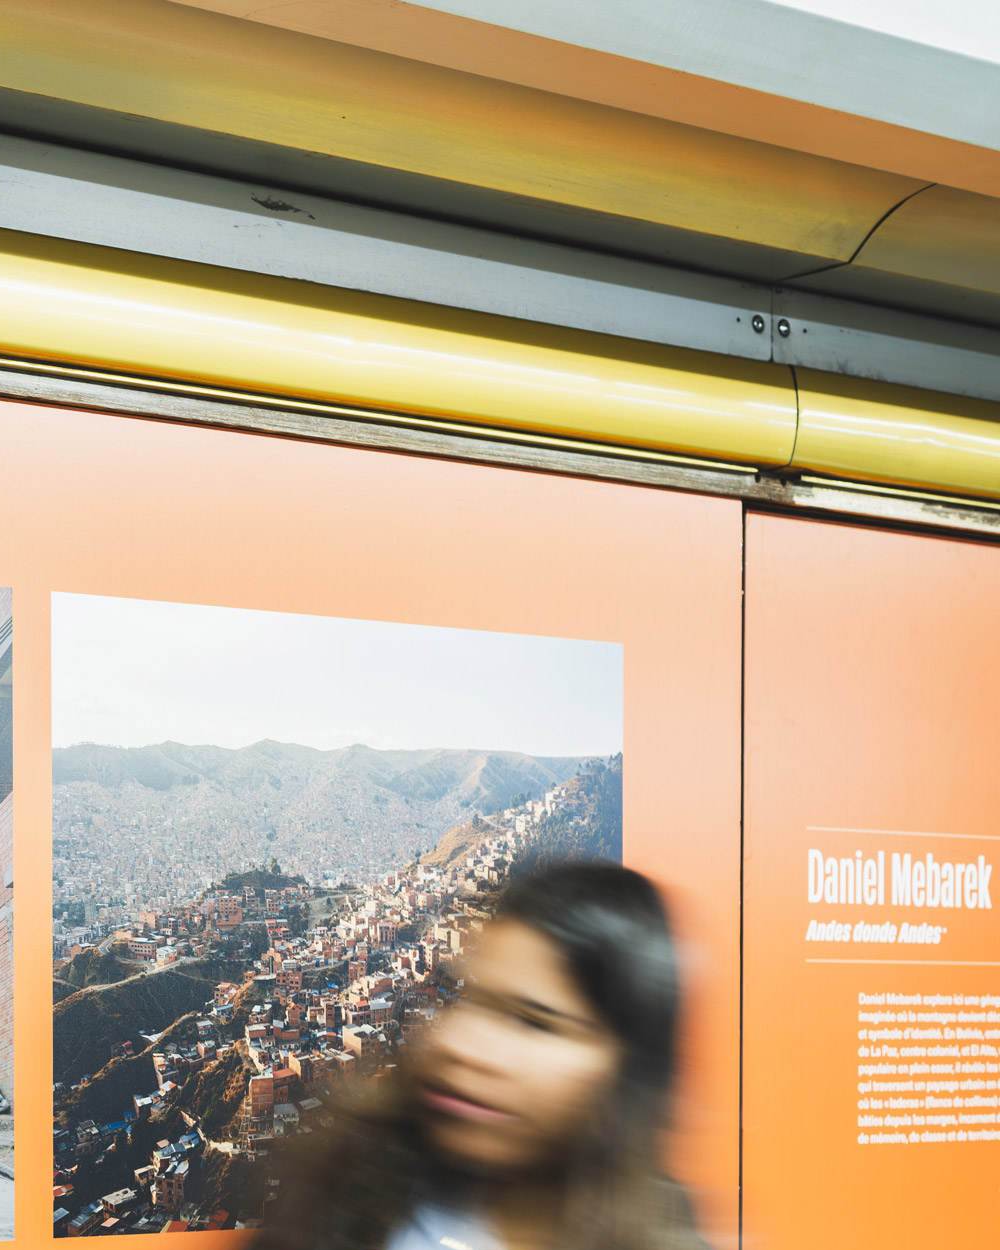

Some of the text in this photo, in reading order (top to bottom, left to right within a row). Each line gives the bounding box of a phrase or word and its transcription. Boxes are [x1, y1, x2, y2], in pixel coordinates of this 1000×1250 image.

[808, 849, 992, 909] Daniel Mebarek
[805, 920, 851, 941] Andes
[853, 921, 897, 943] donde
[859, 992, 885, 1004] Daniel
[859, 1045, 869, 1057] de
[871, 1045, 881, 1057] La
